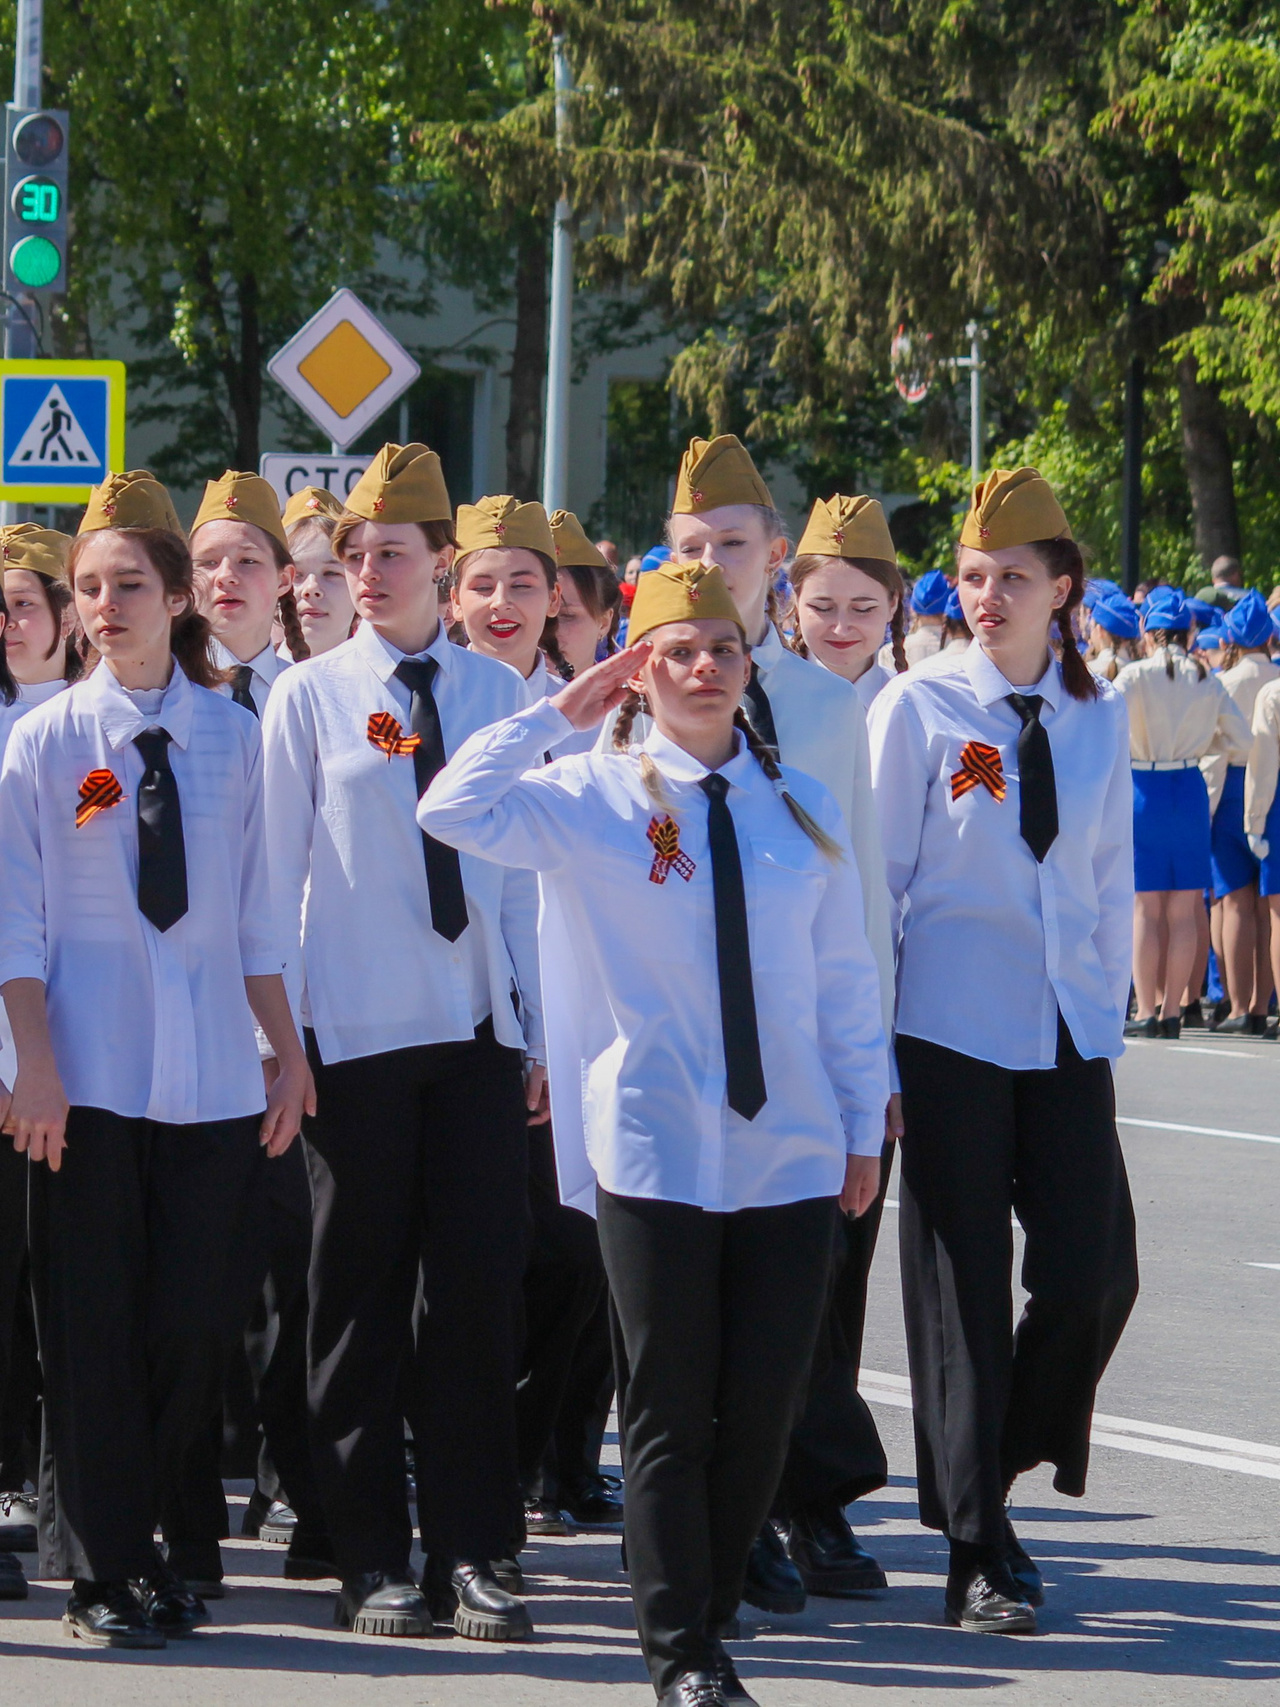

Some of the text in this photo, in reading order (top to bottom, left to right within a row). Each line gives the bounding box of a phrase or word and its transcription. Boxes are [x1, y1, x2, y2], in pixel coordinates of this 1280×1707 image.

[22, 183, 60, 223] 30
[285, 466, 365, 497] СТО
[671, 859, 690, 877] 1945
